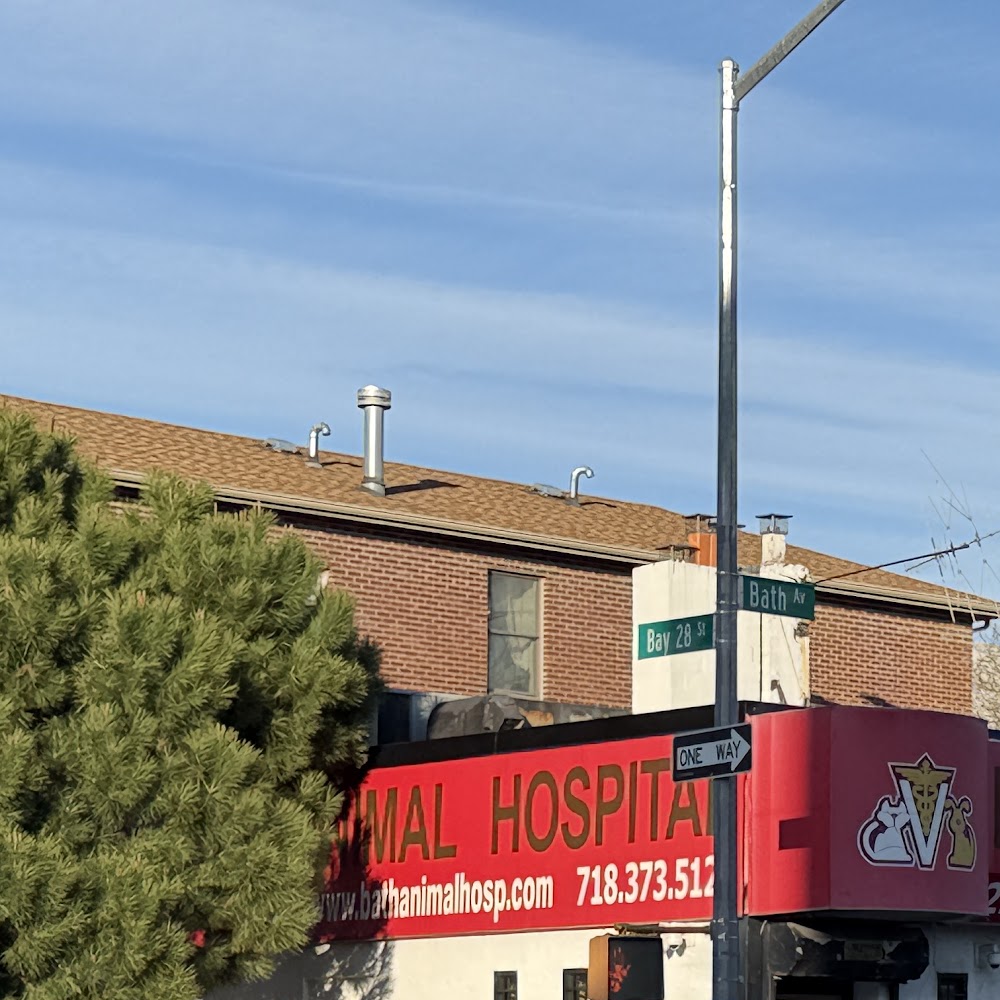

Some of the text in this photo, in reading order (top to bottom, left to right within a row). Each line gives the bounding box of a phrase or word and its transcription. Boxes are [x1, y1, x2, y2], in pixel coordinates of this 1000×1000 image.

[750, 580, 787, 611] Bath
[647, 628, 671, 656] Bay
[676, 623, 692, 648] 28
[680, 740, 741, 767] ONE WAY
[491, 757, 715, 855] HOSPITA
[576, 854, 715, 907] 718.373.512
